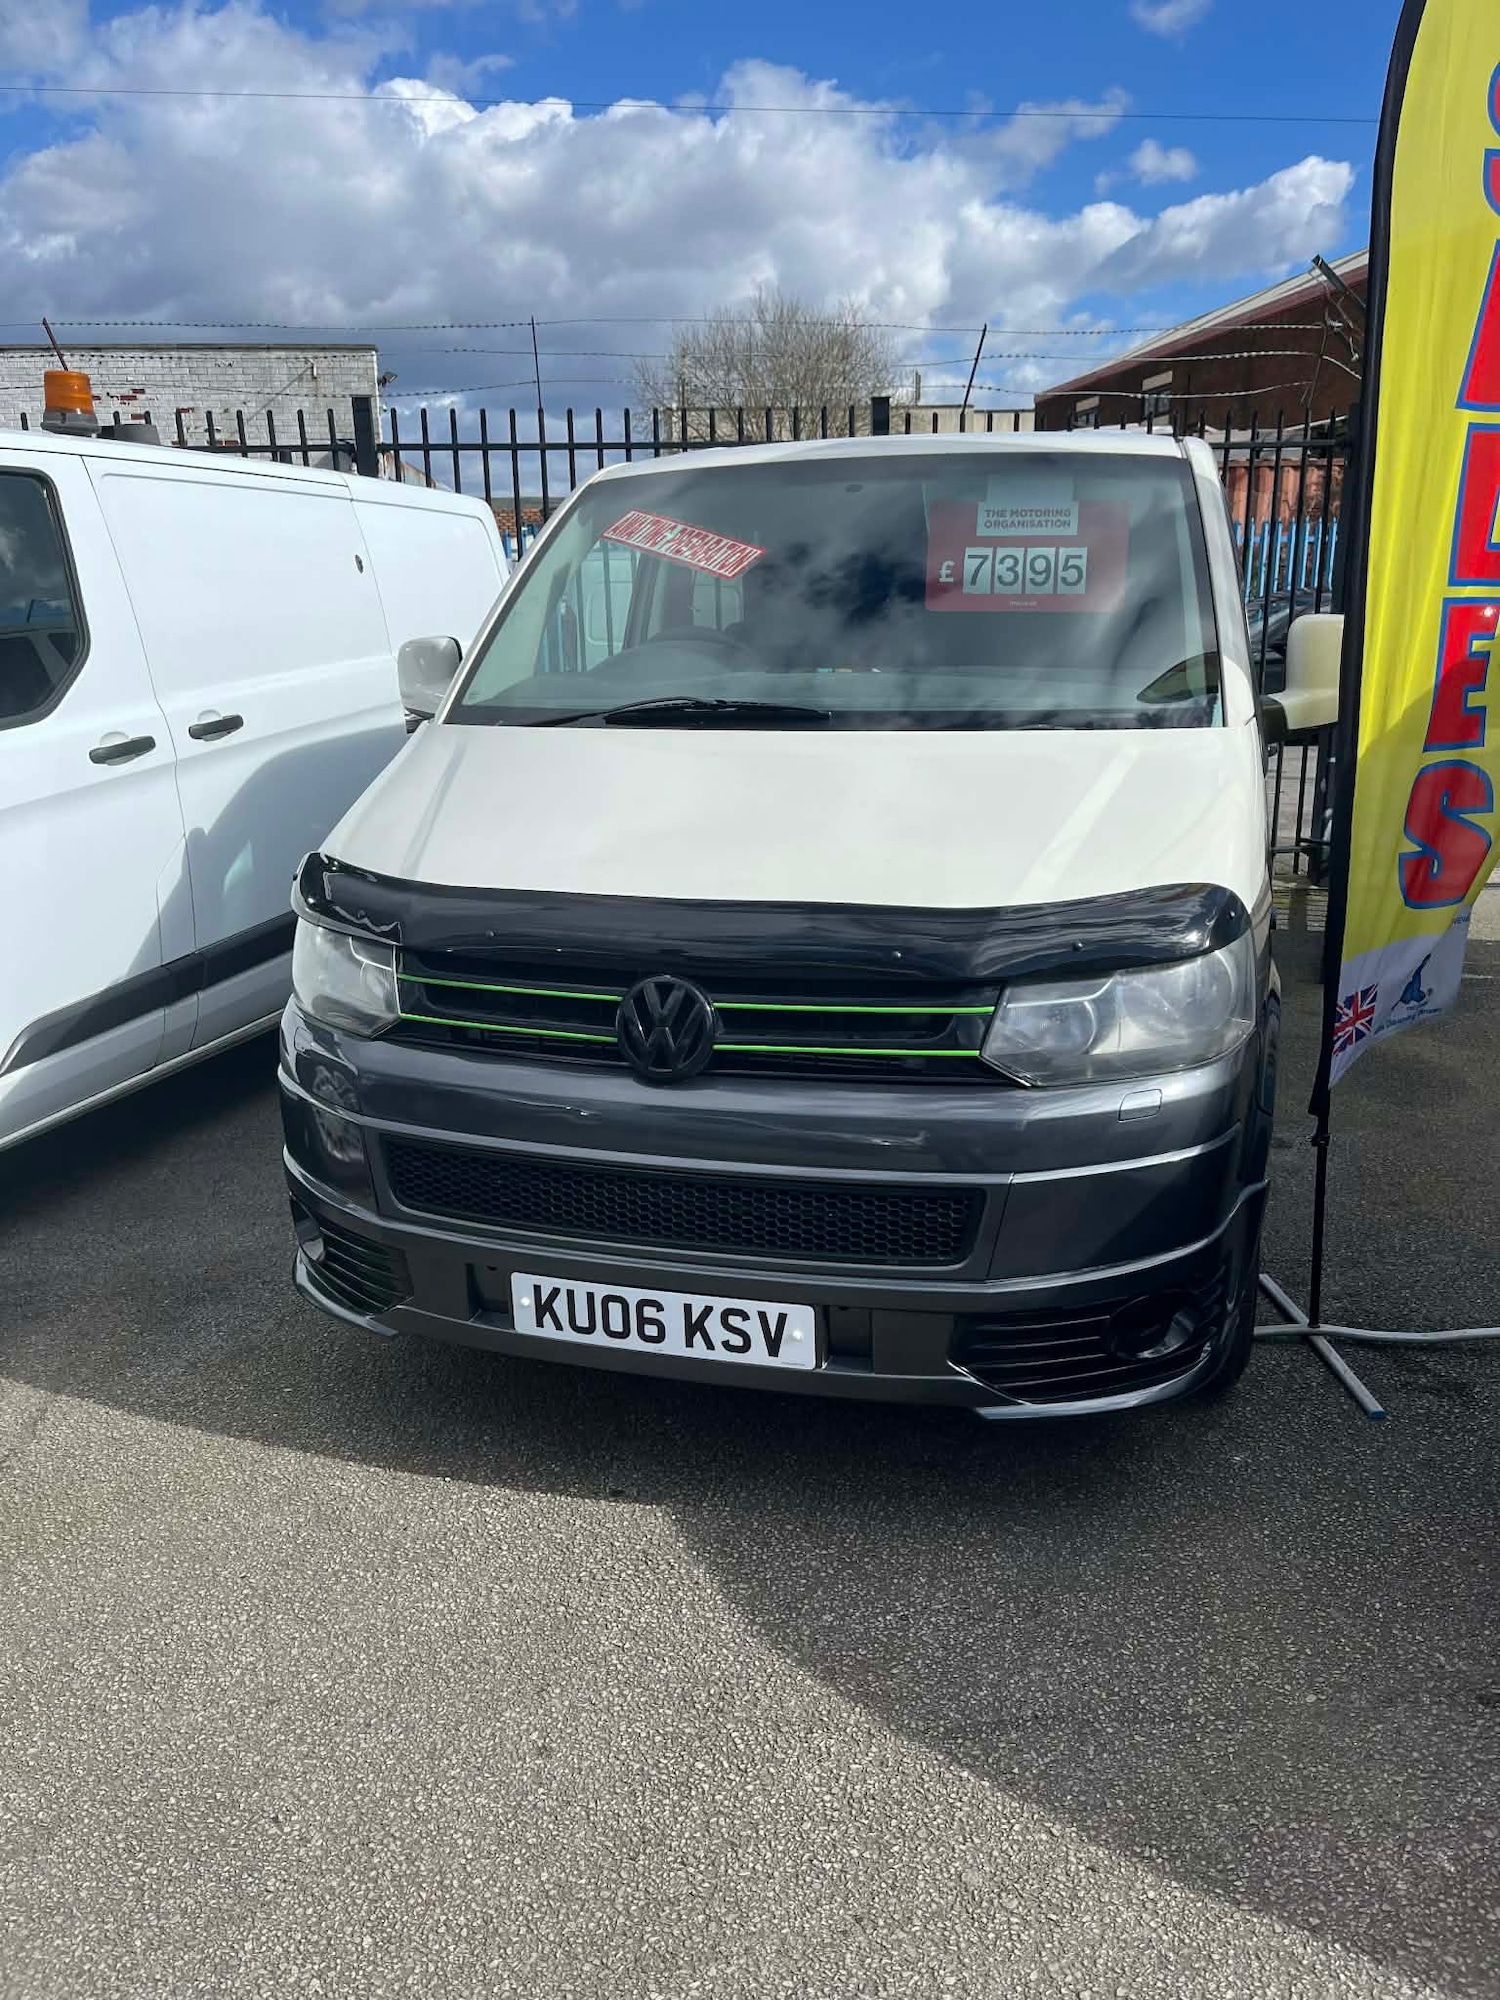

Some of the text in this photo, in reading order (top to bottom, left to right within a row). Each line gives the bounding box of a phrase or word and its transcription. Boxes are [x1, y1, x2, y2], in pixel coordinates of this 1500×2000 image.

[984, 508, 1071, 518] THE MOTORING
[984, 519, 1071, 529] ORGANISATION
[533, 1284, 788, 1358] KU06 KSV
